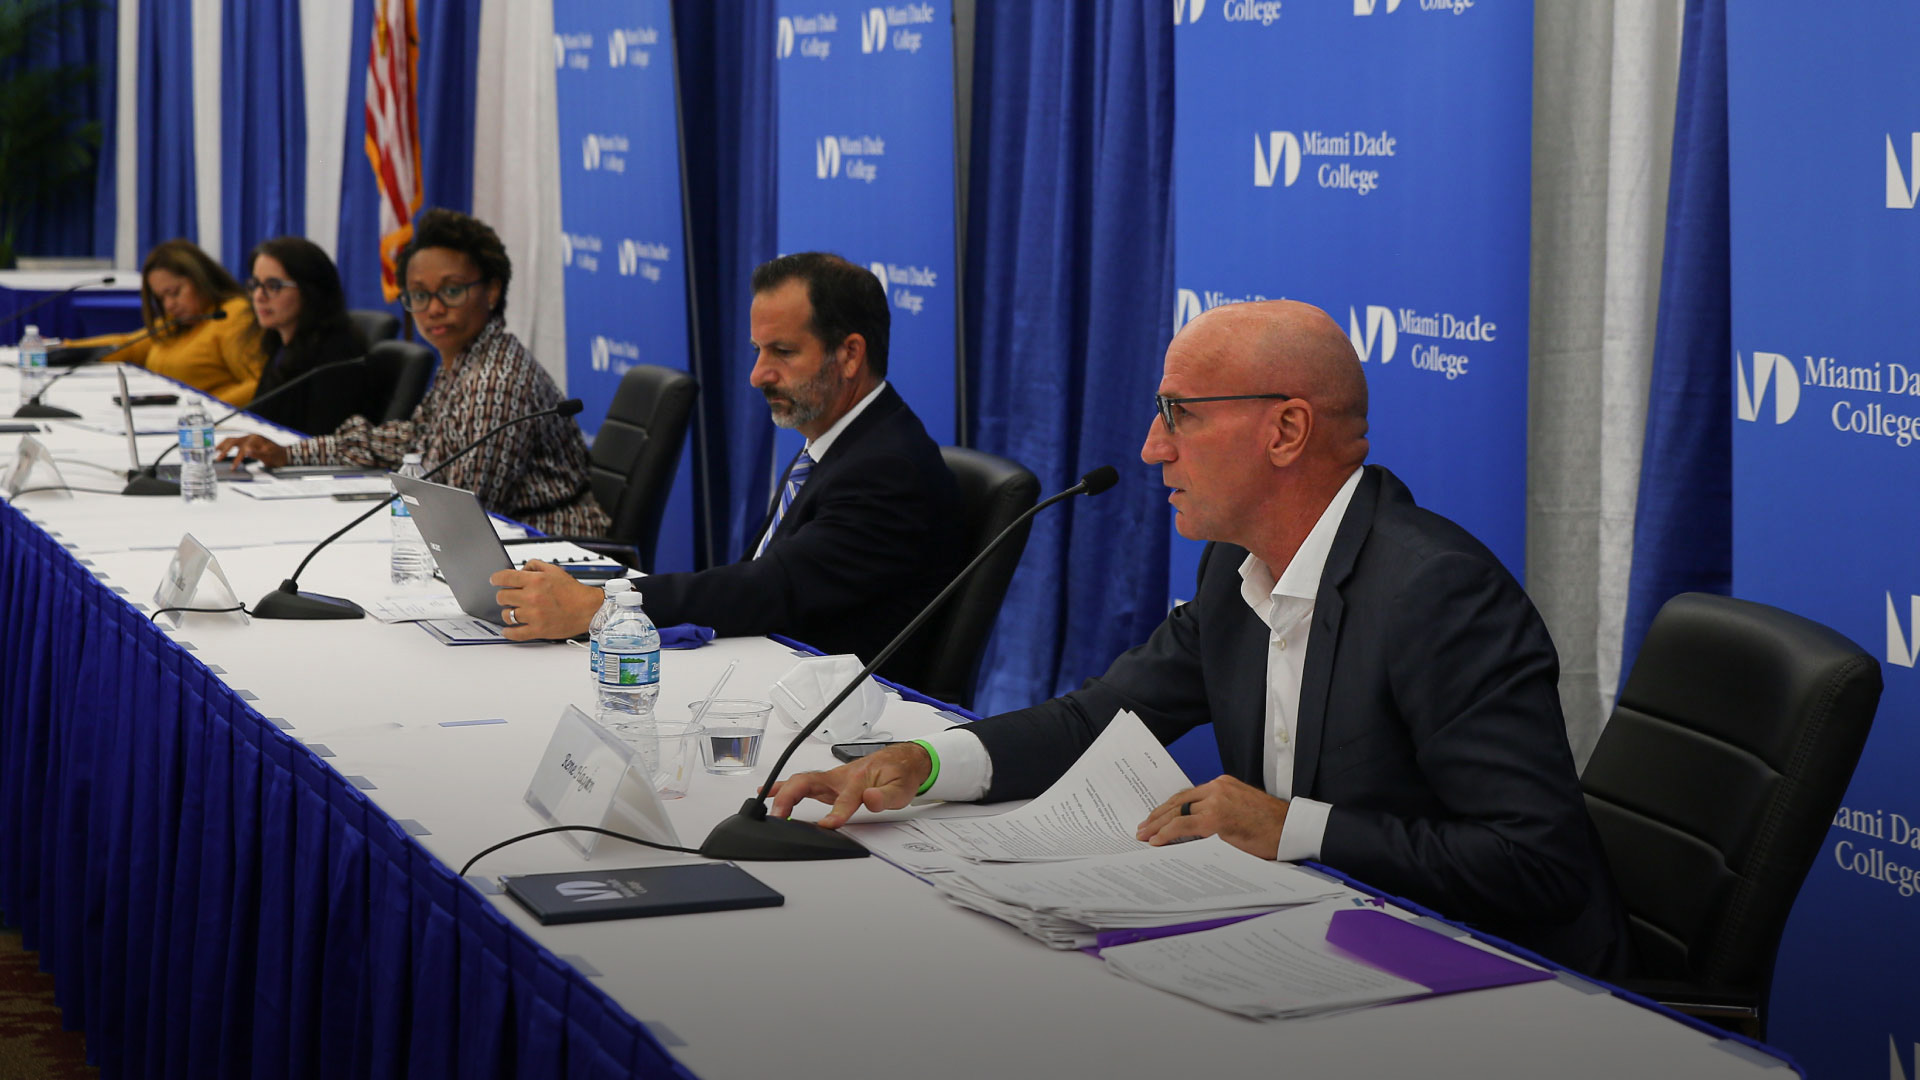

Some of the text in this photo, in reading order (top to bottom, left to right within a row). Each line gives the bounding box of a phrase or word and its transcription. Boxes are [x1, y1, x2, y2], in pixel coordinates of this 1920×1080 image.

[1223, 0, 1282, 27] College
[1302, 130, 1397, 156] Miami Dade
[1317, 163, 1379, 196] College
[1398, 308, 1497, 342] Miami Dade
[1411, 343, 1469, 380] College
[1803, 355, 1882, 393] Miami
[1831, 400, 1920, 447] College
[1834, 840, 1920, 897] College
